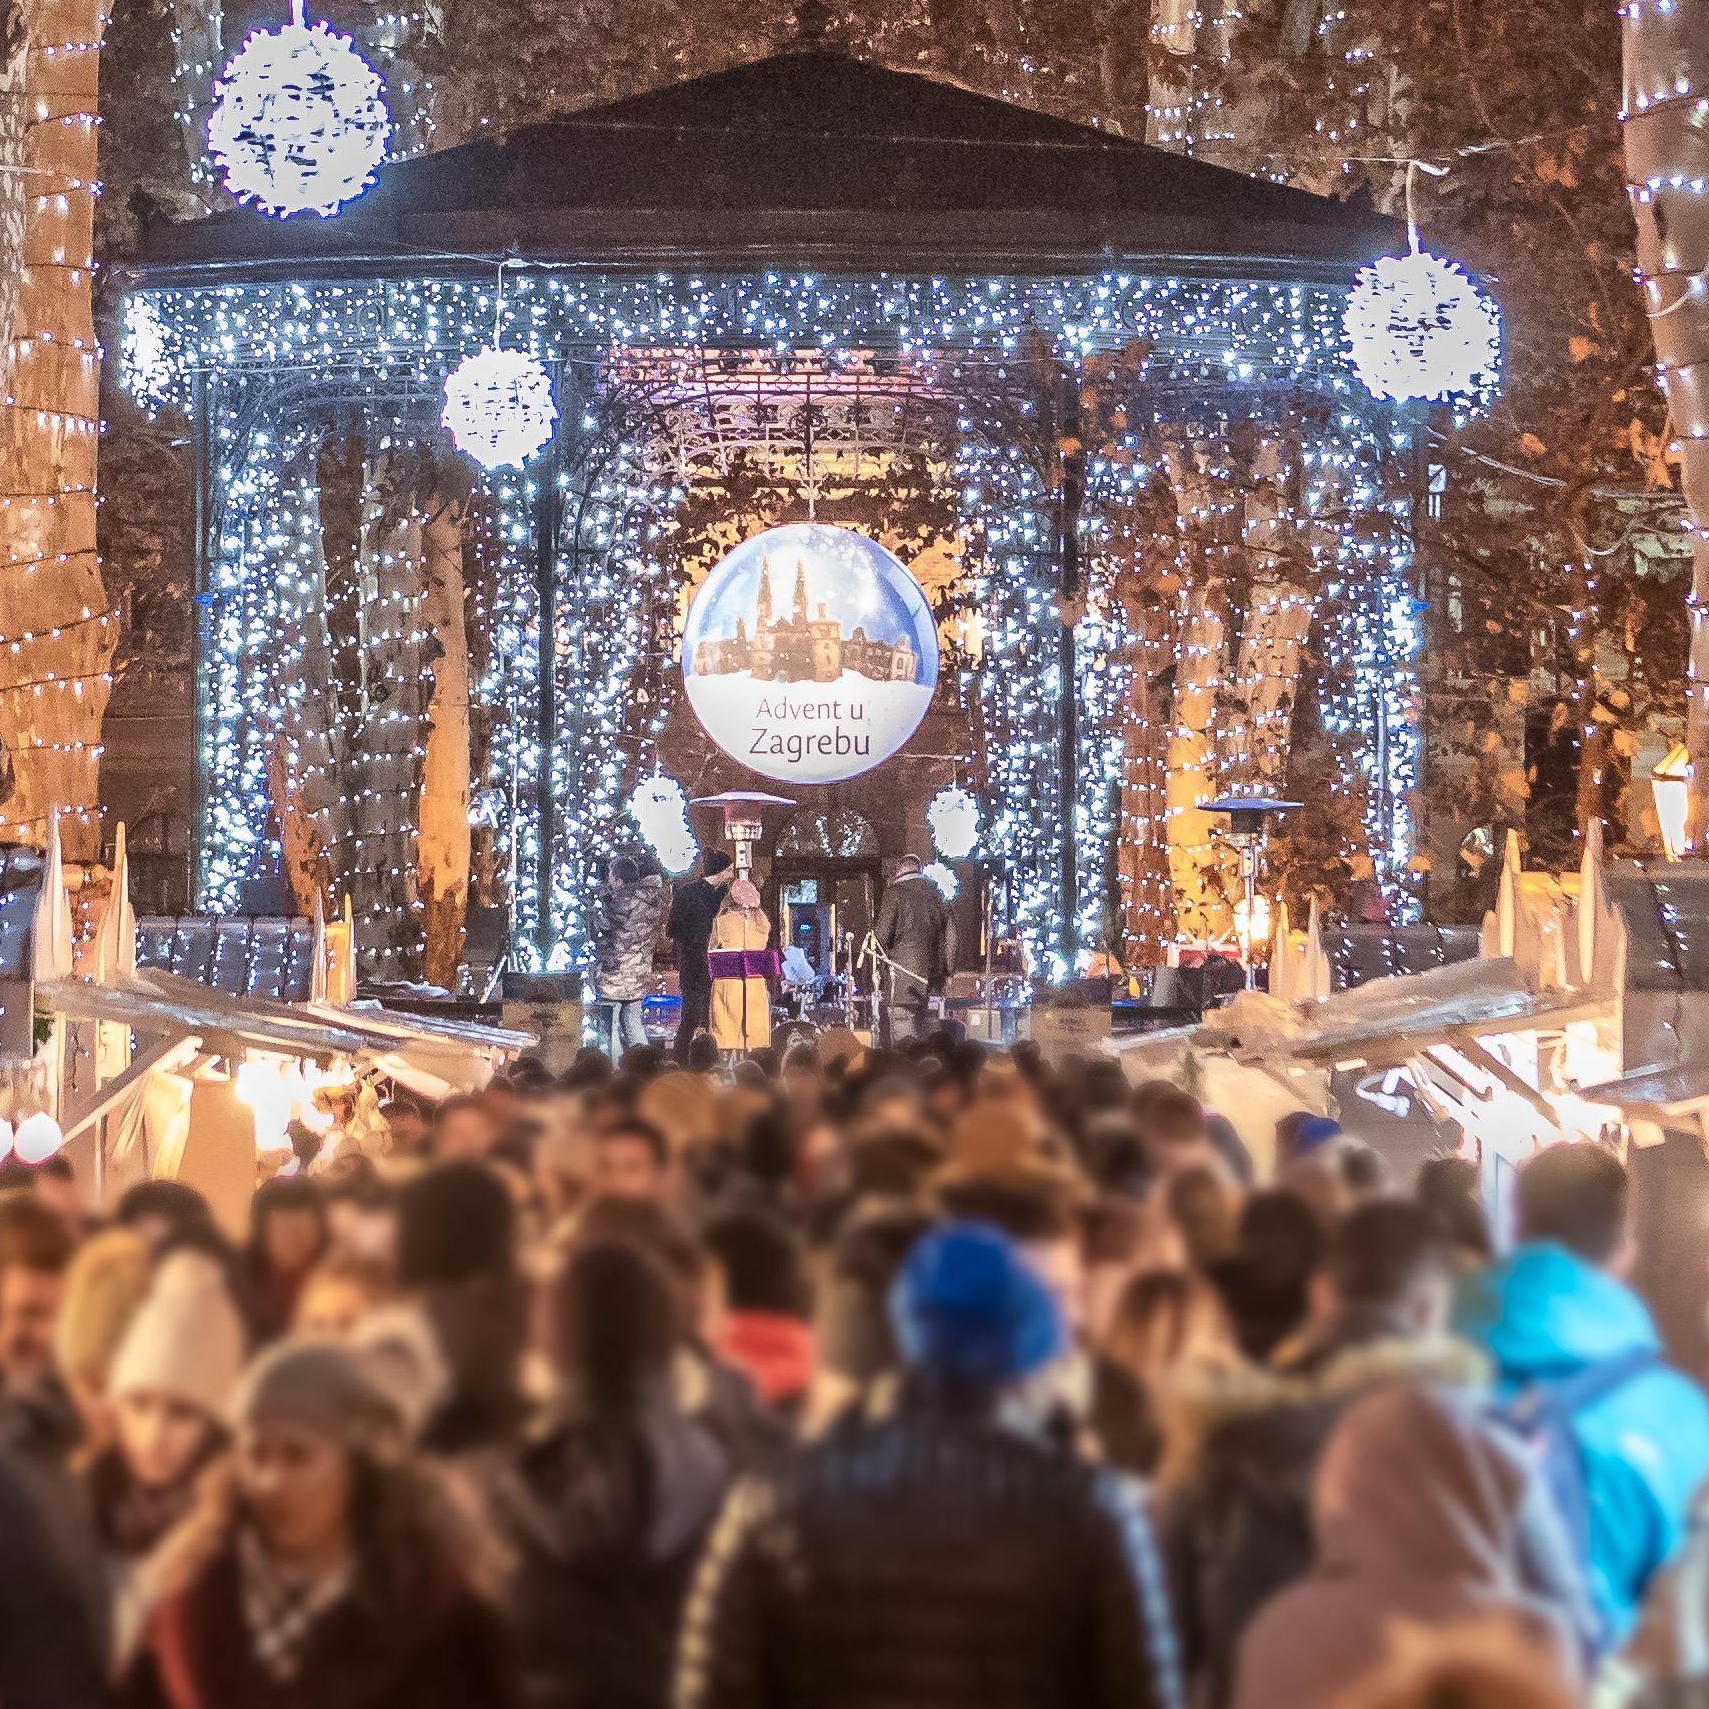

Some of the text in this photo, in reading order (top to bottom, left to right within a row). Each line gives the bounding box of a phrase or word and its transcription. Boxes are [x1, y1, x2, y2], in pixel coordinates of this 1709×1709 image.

[756, 696, 863, 720] Advent u
[749, 725, 870, 763] Zagrebu
